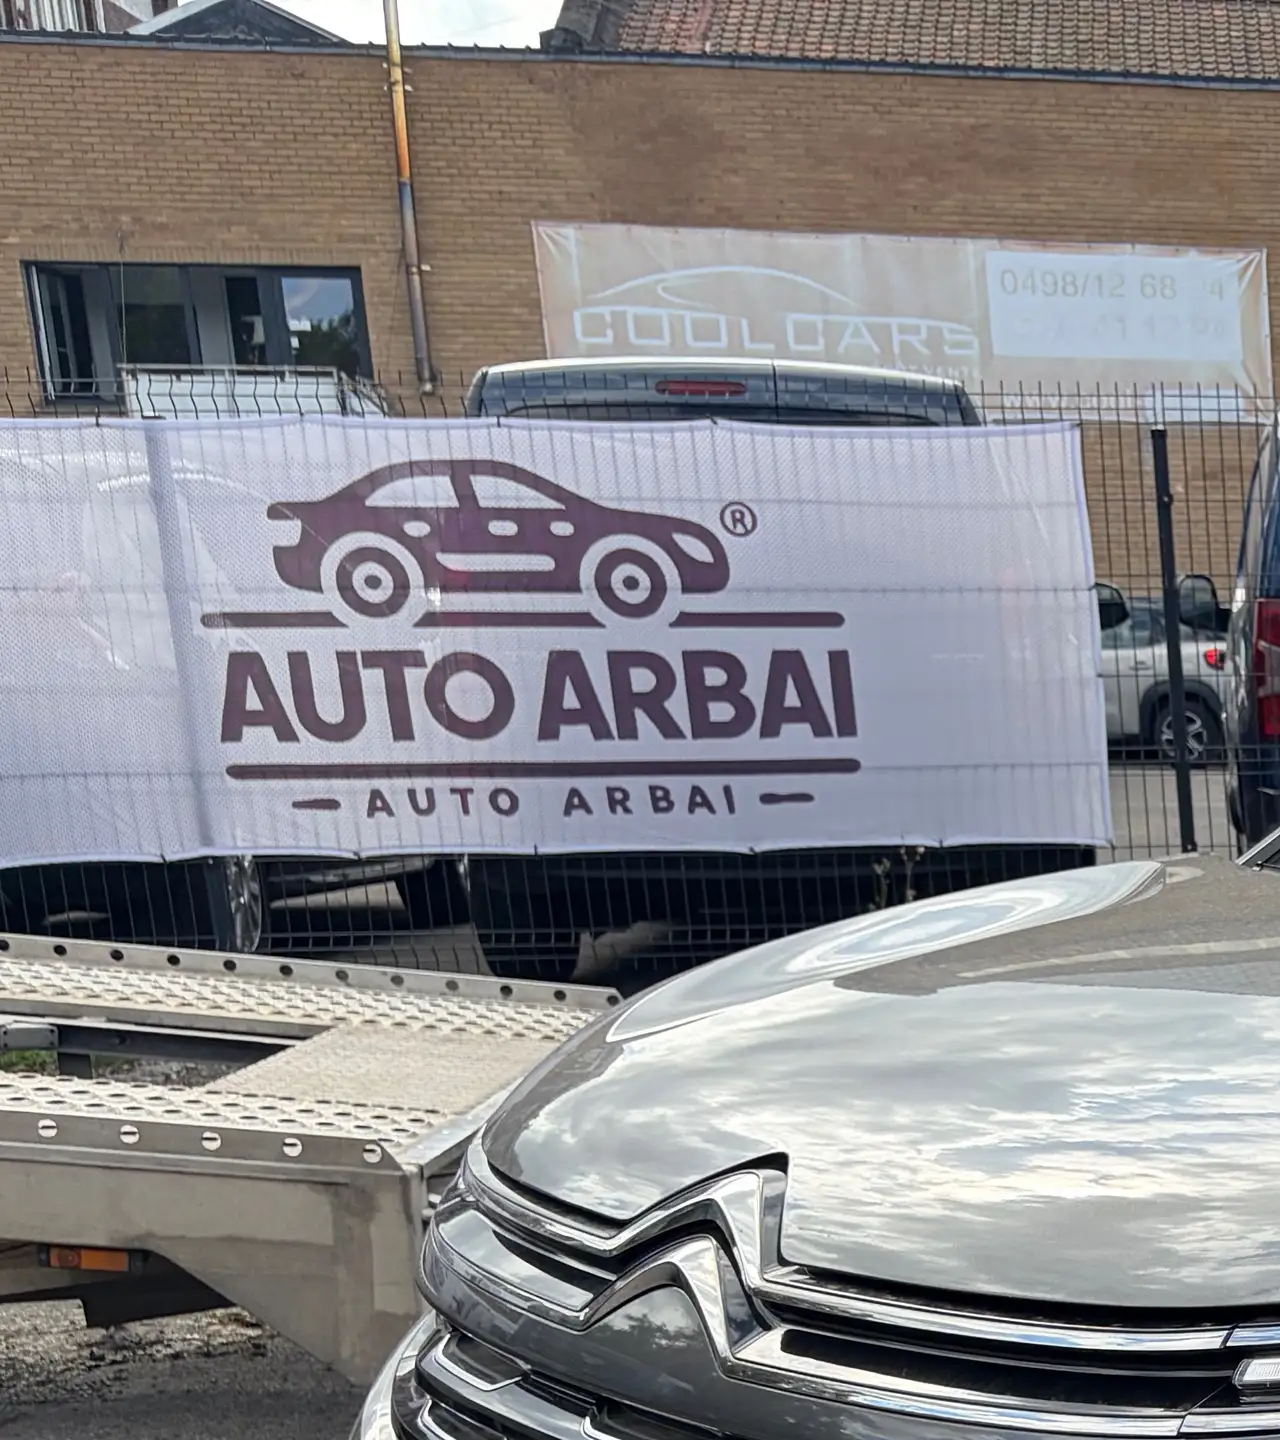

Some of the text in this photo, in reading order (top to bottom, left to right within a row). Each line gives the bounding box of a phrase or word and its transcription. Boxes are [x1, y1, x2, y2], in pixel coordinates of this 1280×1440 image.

[1000, 268, 1126, 298] 0498/12
[1139, 272, 1177, 299] 68
[220, 648, 859, 743] AUTO ARBAI
[366, 784, 737, 818] AUTO ARBAI
